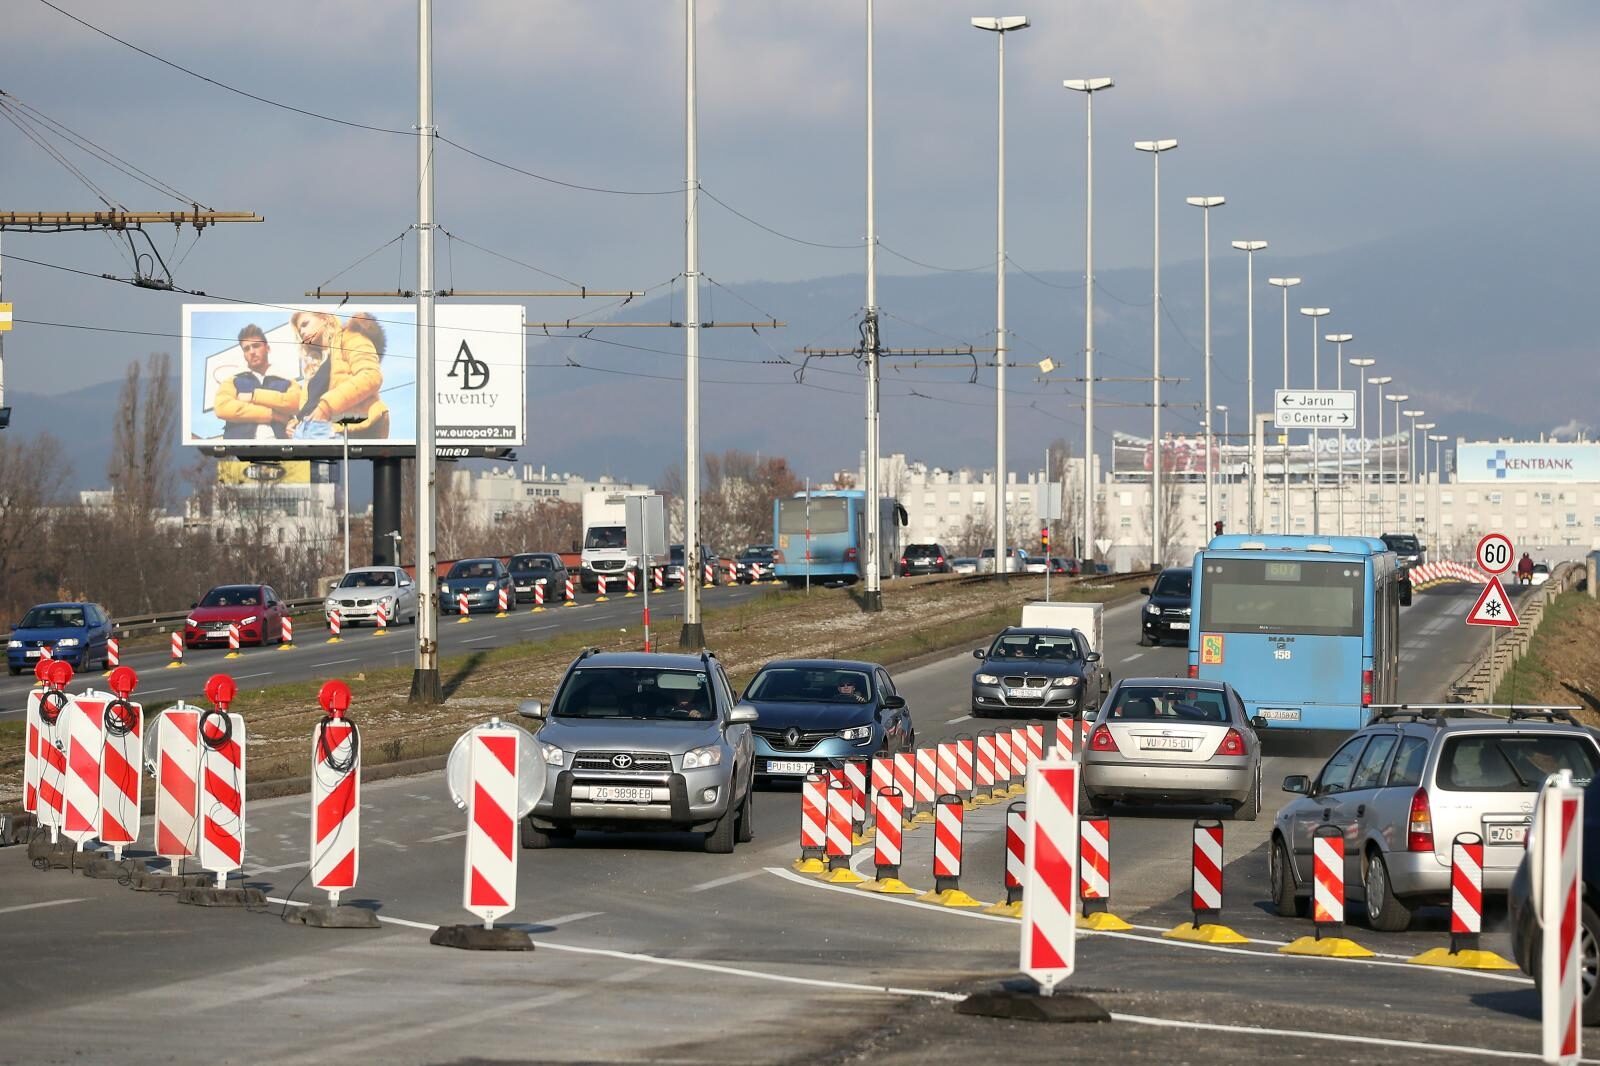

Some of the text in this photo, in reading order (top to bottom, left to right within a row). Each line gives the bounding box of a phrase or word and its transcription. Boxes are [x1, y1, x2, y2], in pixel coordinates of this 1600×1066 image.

[437, 392, 499, 408] twenty
[1299, 395, 1334, 406] Jarun
[1294, 412, 1333, 423] Centar
[1309, 433, 1371, 453] beko
[1505, 459, 1573, 470] KENTBANK
[1485, 544, 1506, 563] 60
[1273, 650, 1292, 660] 158
[1146, 737, 1157, 747] VU
[772, 762, 782, 771] PU
[596, 787, 608, 798] ZG
[1498, 828, 1513, 841] ZG
